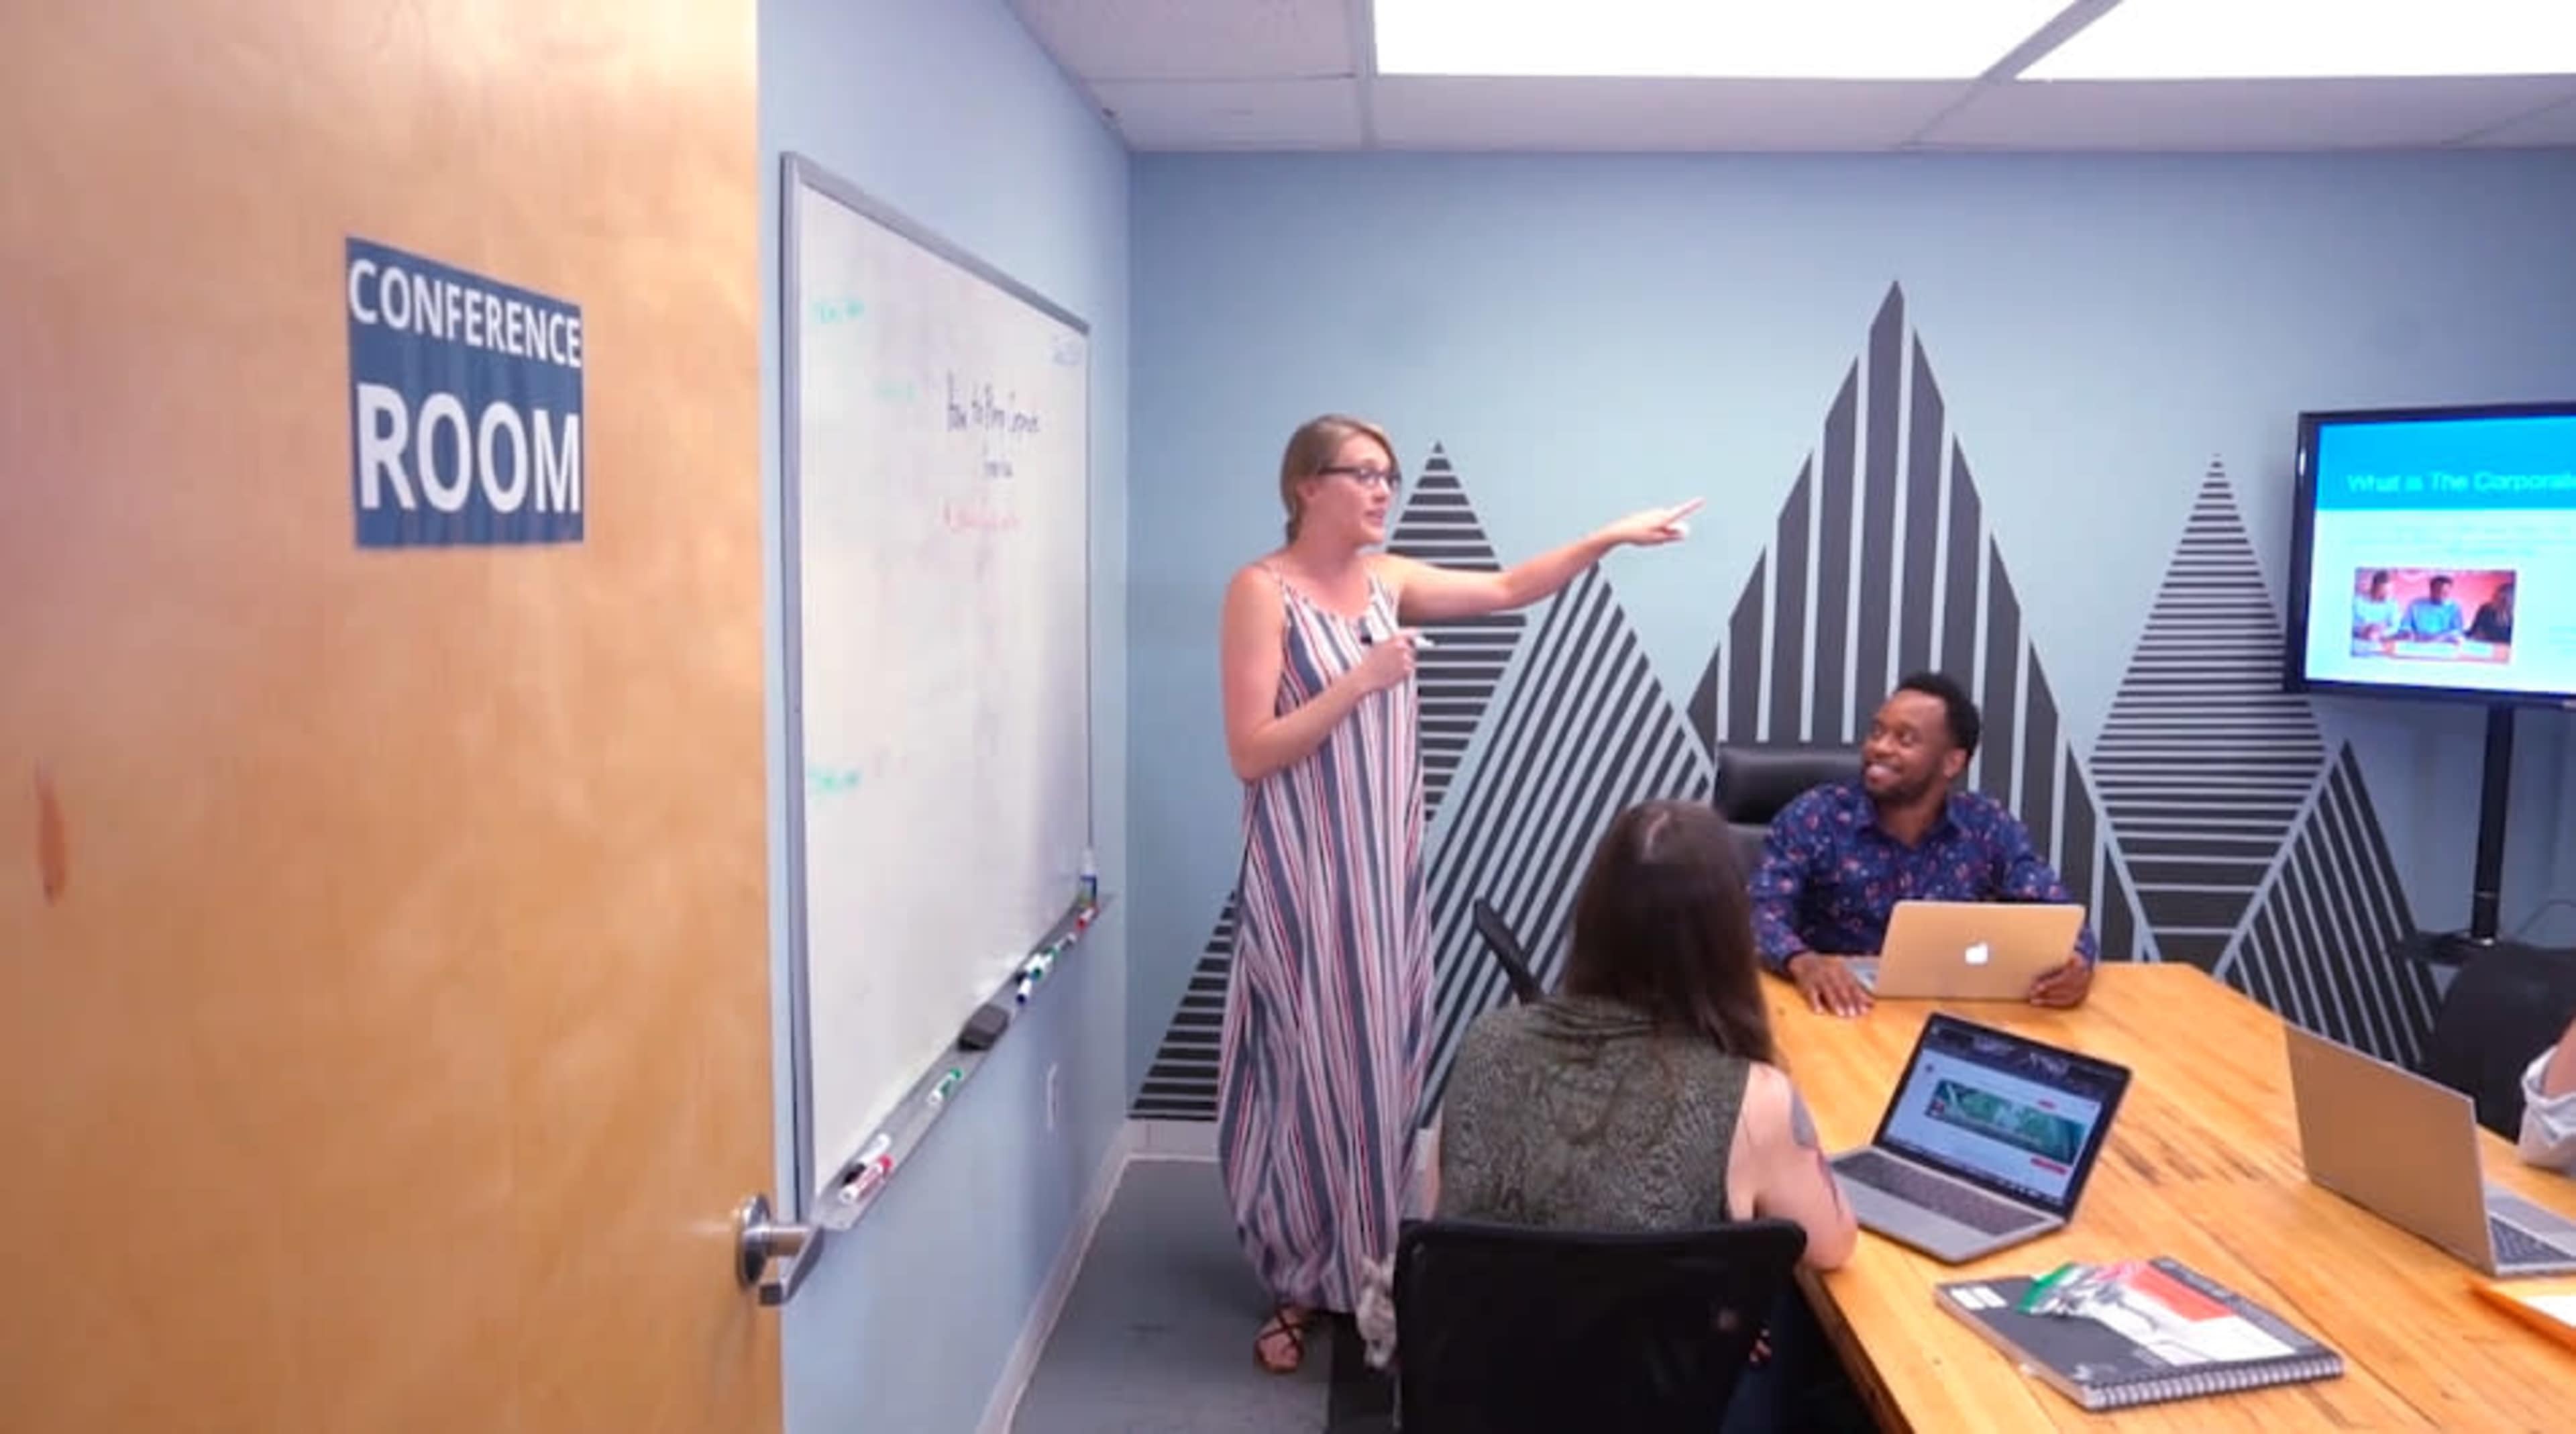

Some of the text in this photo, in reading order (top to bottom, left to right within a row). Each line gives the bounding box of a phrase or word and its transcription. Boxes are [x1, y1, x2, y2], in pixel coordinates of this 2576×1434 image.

[350, 258, 582, 368] CONFERENCE
[357, 382, 580, 514] ROOM
[2347, 473, 2400, 493] What
[2428, 471, 2469, 491] The
